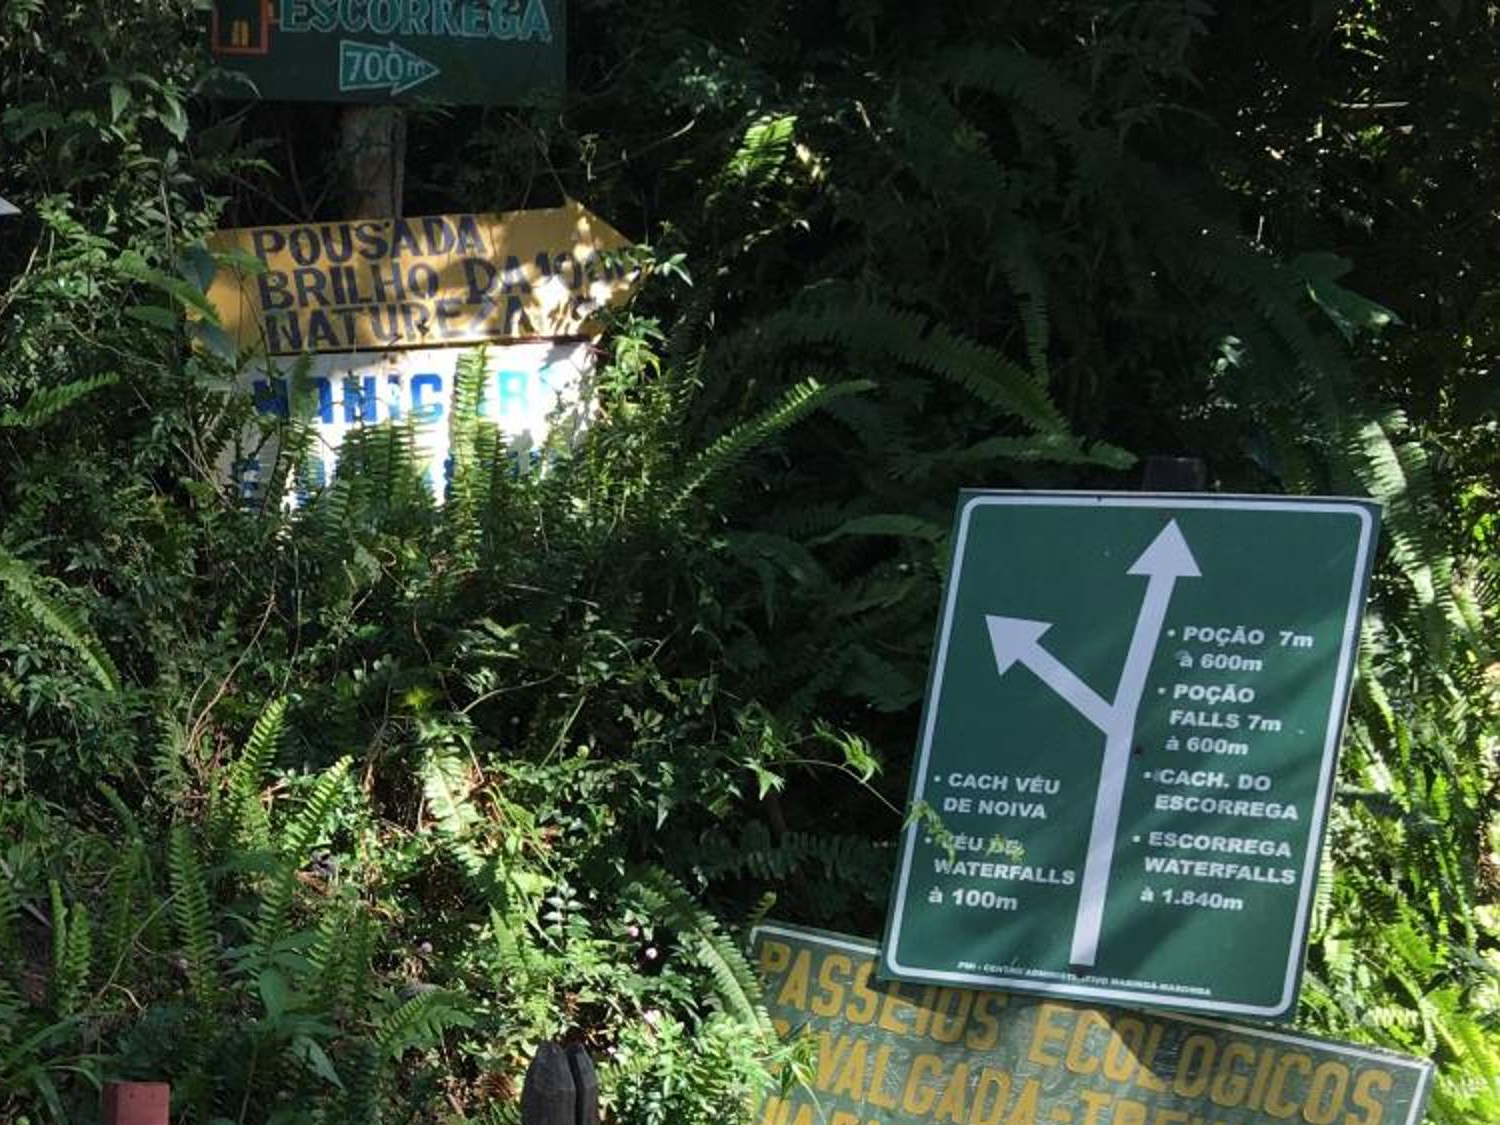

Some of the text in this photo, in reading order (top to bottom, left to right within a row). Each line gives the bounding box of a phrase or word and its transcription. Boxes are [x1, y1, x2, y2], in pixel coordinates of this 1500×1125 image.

[278, 0, 552, 42] ESCORREGA
[251, 215, 487, 267] POUSADA
[258, 261, 439, 311] BRILHO
[1182, 625, 1315, 648] POÇÃO 7m
[1201, 653, 1264, 671] 600m
[1173, 683, 1255, 705] POÇÃO
[1169, 709, 1282, 732] FALLS 7m
[1186, 736, 1249, 755] 600m
[948, 772, 1061, 795] CACH VÉU
[1159, 769, 1272, 791] CACH. DO
[943, 797, 1047, 819] DE NOIVA
[1154, 794, 1299, 820] ESCORREGA
[941, 834, 983, 851] ÉU
[1149, 831, 1292, 858] ESCORREGA
[933, 858, 1076, 885] WATERFALLS
[1144, 857, 1297, 884] WATERFALLS
[952, 888, 1019, 911] 100m
[758, 939, 1010, 1052] PASSEIOS
